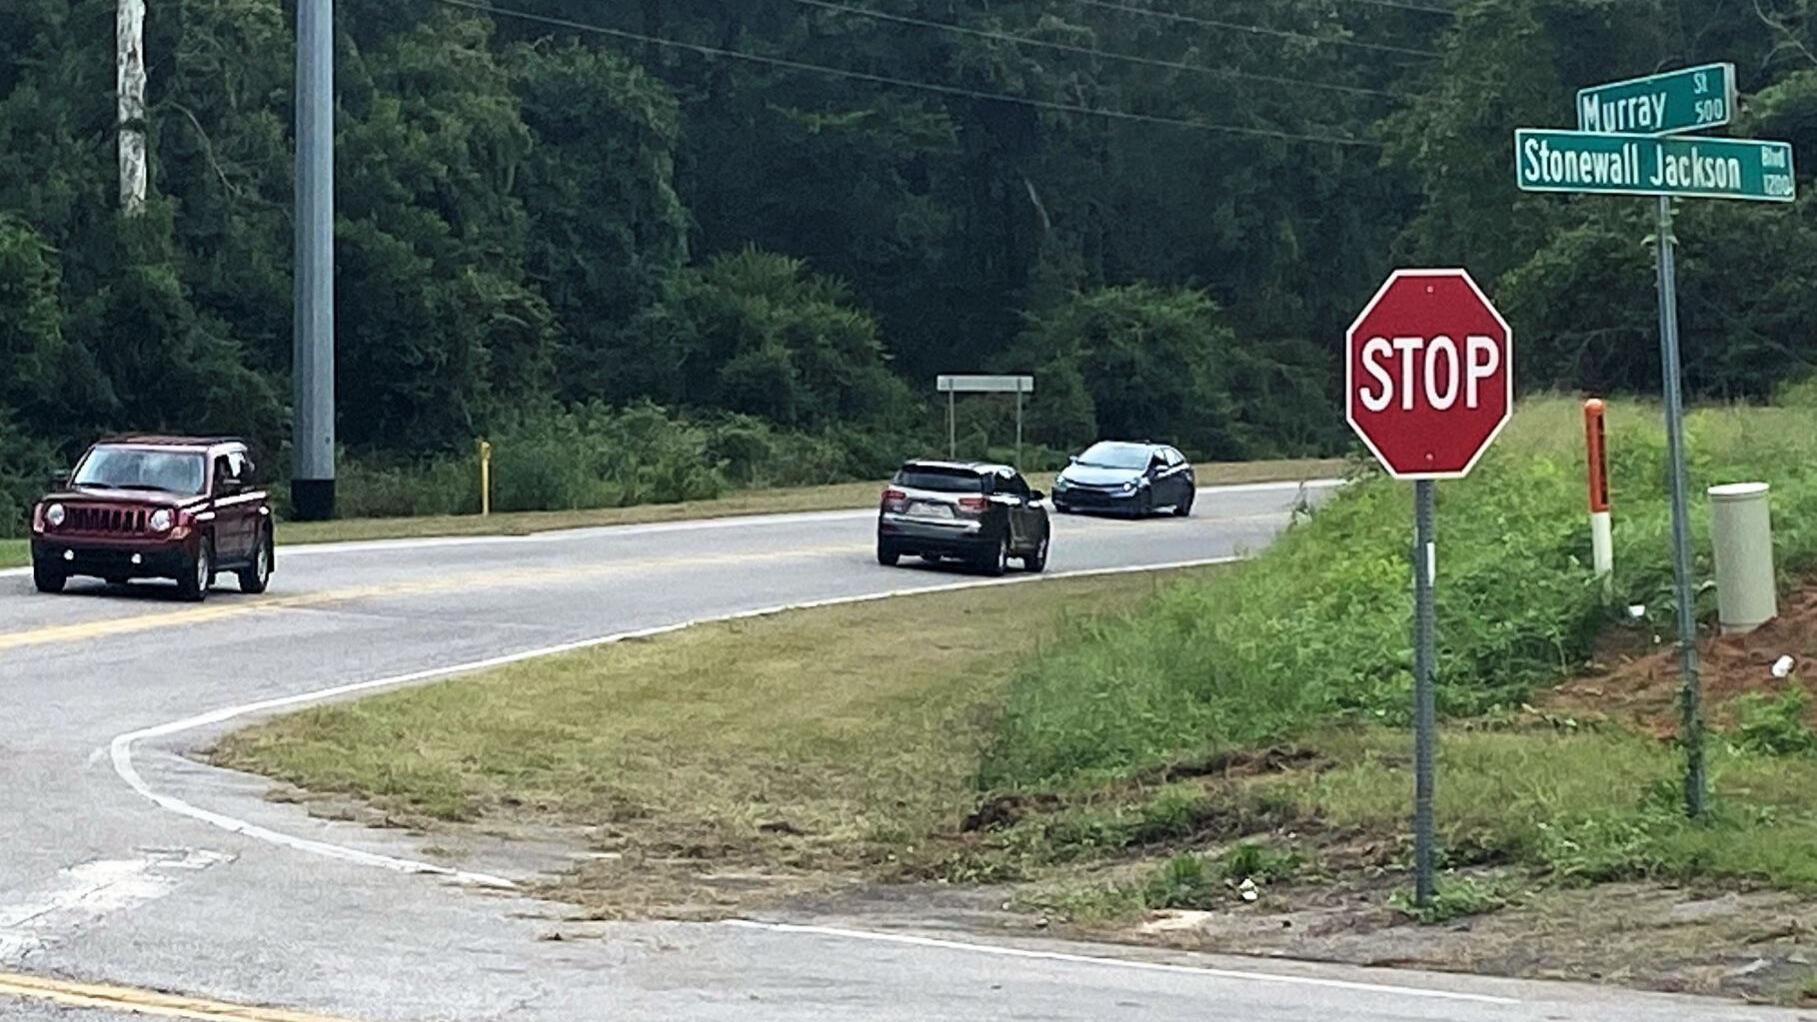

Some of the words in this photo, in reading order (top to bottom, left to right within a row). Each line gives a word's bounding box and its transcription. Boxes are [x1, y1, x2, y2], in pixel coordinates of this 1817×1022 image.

[1582, 92, 1667, 132] Murray
[1695, 98, 1724, 124] 500
[1524, 138, 1640, 185] Stonewall
[1650, 143, 1741, 190] Jackson
[1761, 145, 1786, 169] Blvd
[1359, 335, 1499, 412] STOP
